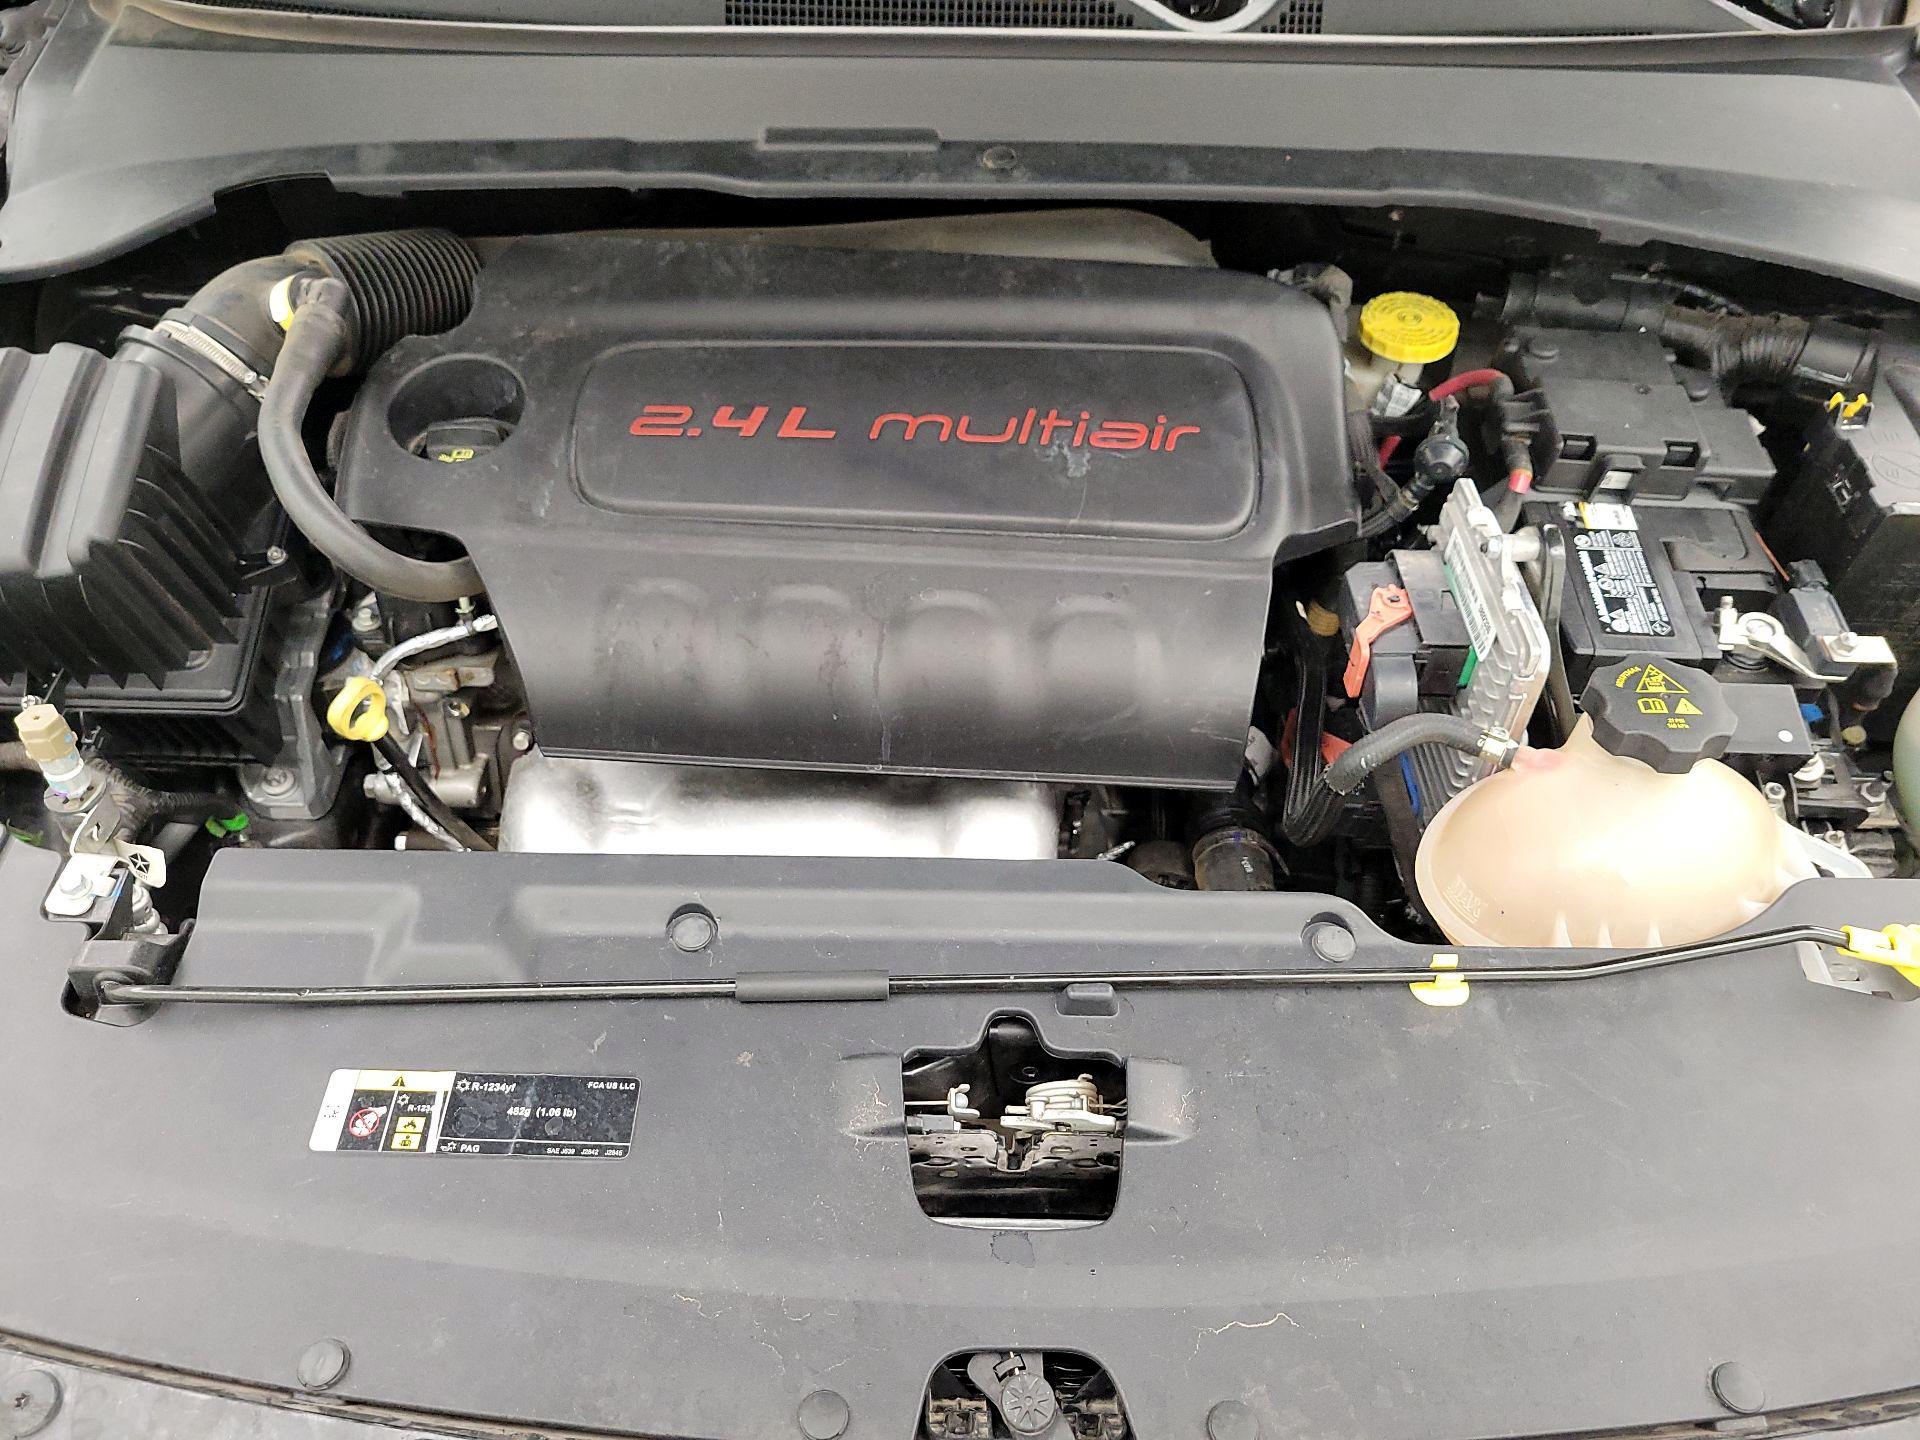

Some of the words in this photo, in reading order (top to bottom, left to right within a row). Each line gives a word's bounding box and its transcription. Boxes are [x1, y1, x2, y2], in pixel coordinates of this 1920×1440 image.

[869, 407, 1201, 452] multiair
[471, 1082, 517, 1094] R-1234yf
[587, 1081, 605, 1090] FCA
[605, 1082, 618, 1090] US
[619, 1083, 636, 1091] LLC
[563, 1108, 577, 1120] lb)
[460, 1144, 480, 1153] PAG
[546, 1147, 560, 1155] SAE
